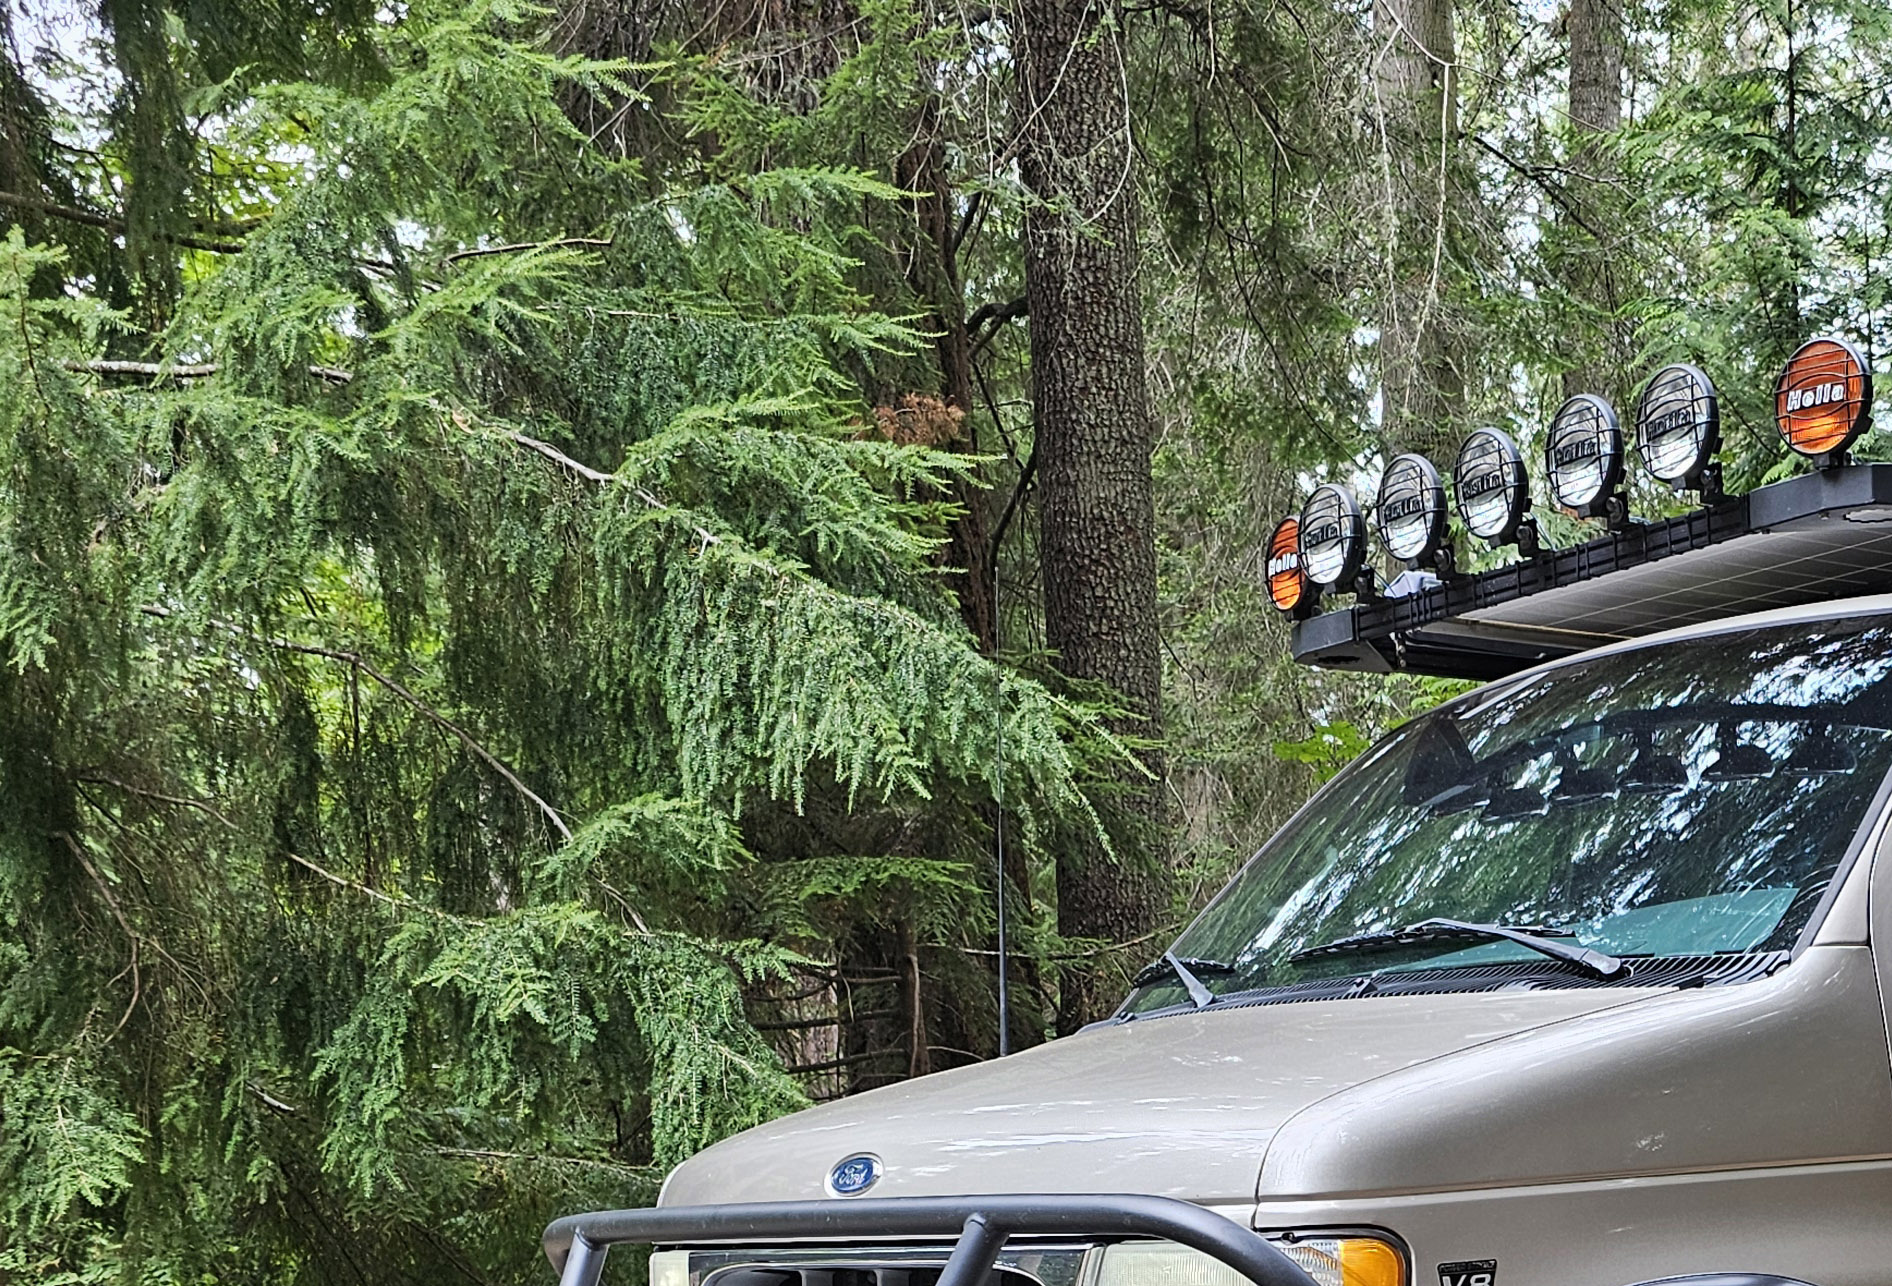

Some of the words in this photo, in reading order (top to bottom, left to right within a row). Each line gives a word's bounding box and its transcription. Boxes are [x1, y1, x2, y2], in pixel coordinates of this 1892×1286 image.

[1786, 383, 1844, 412] Hella
[1268, 553, 1298, 577] Hella
[838, 1162, 868, 1186] Ford
